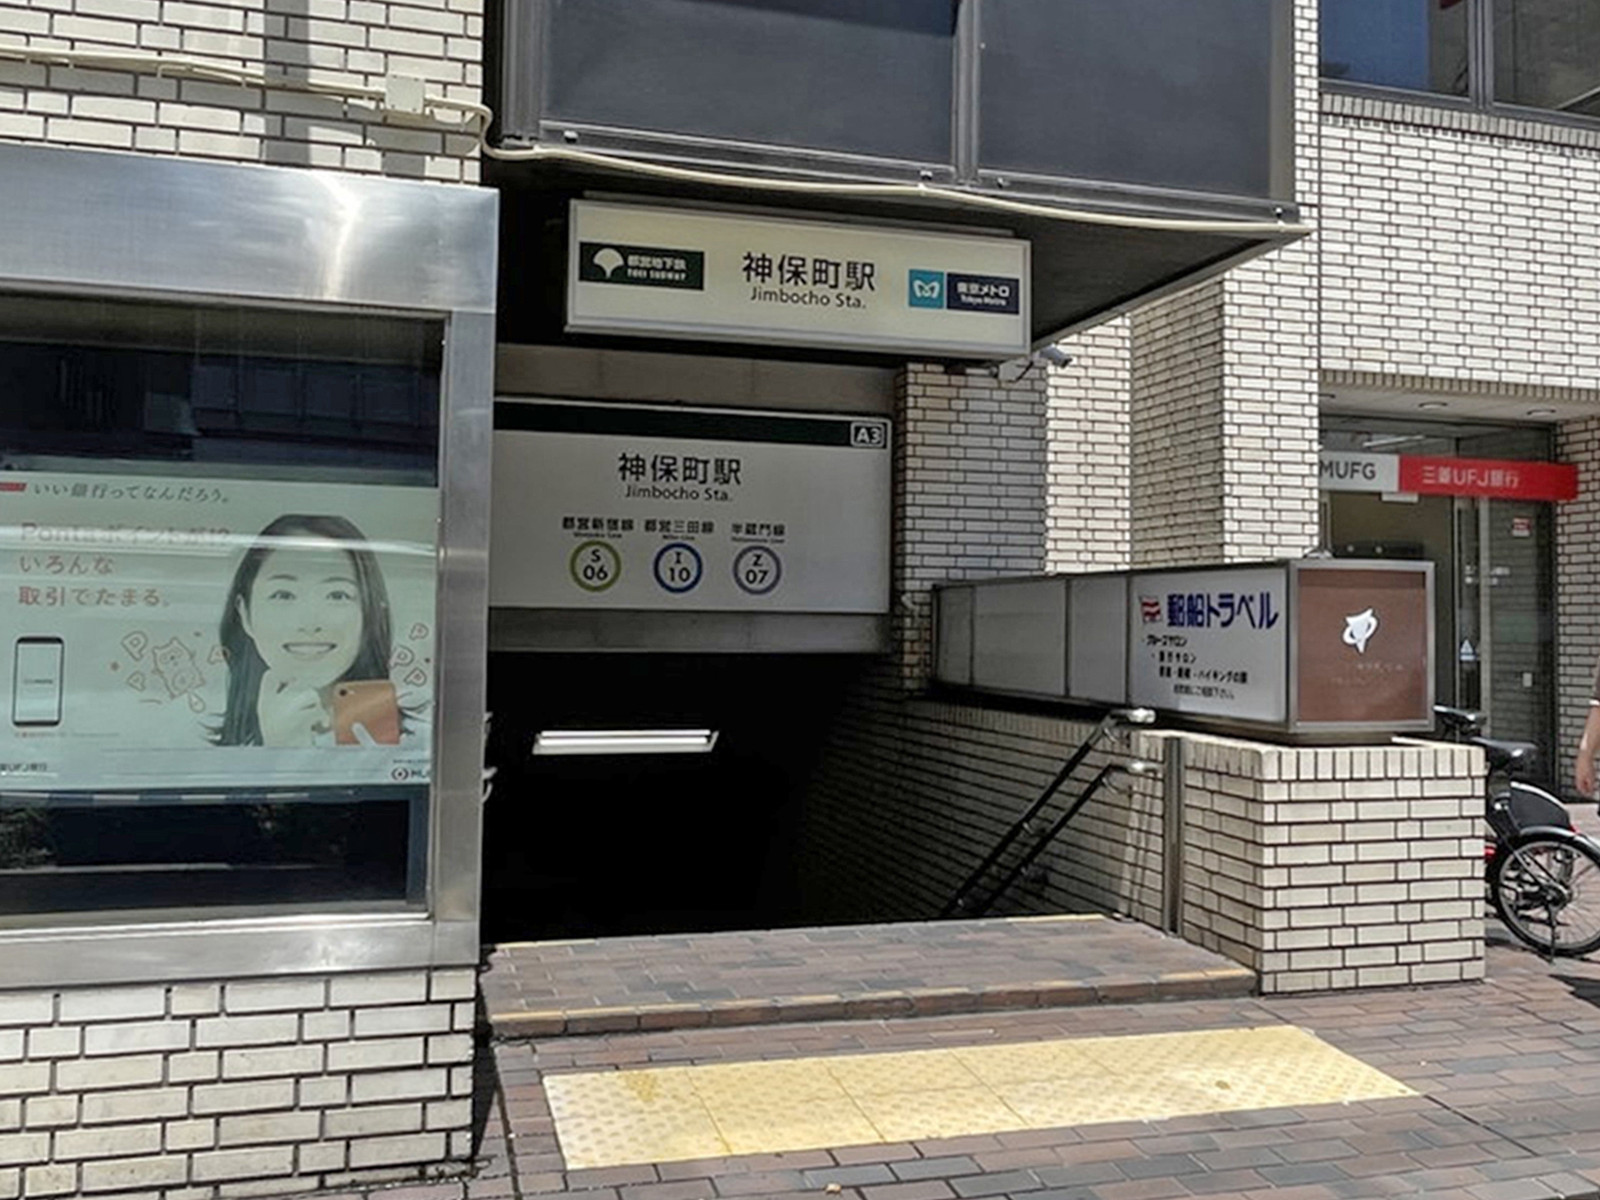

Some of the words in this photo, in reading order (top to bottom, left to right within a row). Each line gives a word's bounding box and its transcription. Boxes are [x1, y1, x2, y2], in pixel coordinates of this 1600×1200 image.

[742, 251, 875, 291] 神保町駅
[751, 286, 831, 306] Jimbocho
[835, 293, 866, 309] Sta.
[957, 282, 1010, 298] 東京メトロ
[856, 427, 882, 444] A3
[618, 452, 741, 485] 神保町駅
[1318, 460, 1376, 481] MUFG
[1422, 464, 1521, 489] 三菱UFJ銀行
[625, 485, 699, 500] Jimbocho
[703, 487, 733, 502] Sta.
[20, 555, 114, 575] いろんな
[590, 549, 602, 564] S
[674, 551, 682, 564] I
[752, 553, 763, 567] Z
[583, 564, 609, 581] 06
[669, 566, 692, 583] 10
[745, 568, 770, 585] 07
[1167, 592, 1280, 630] 郵船トラベル
